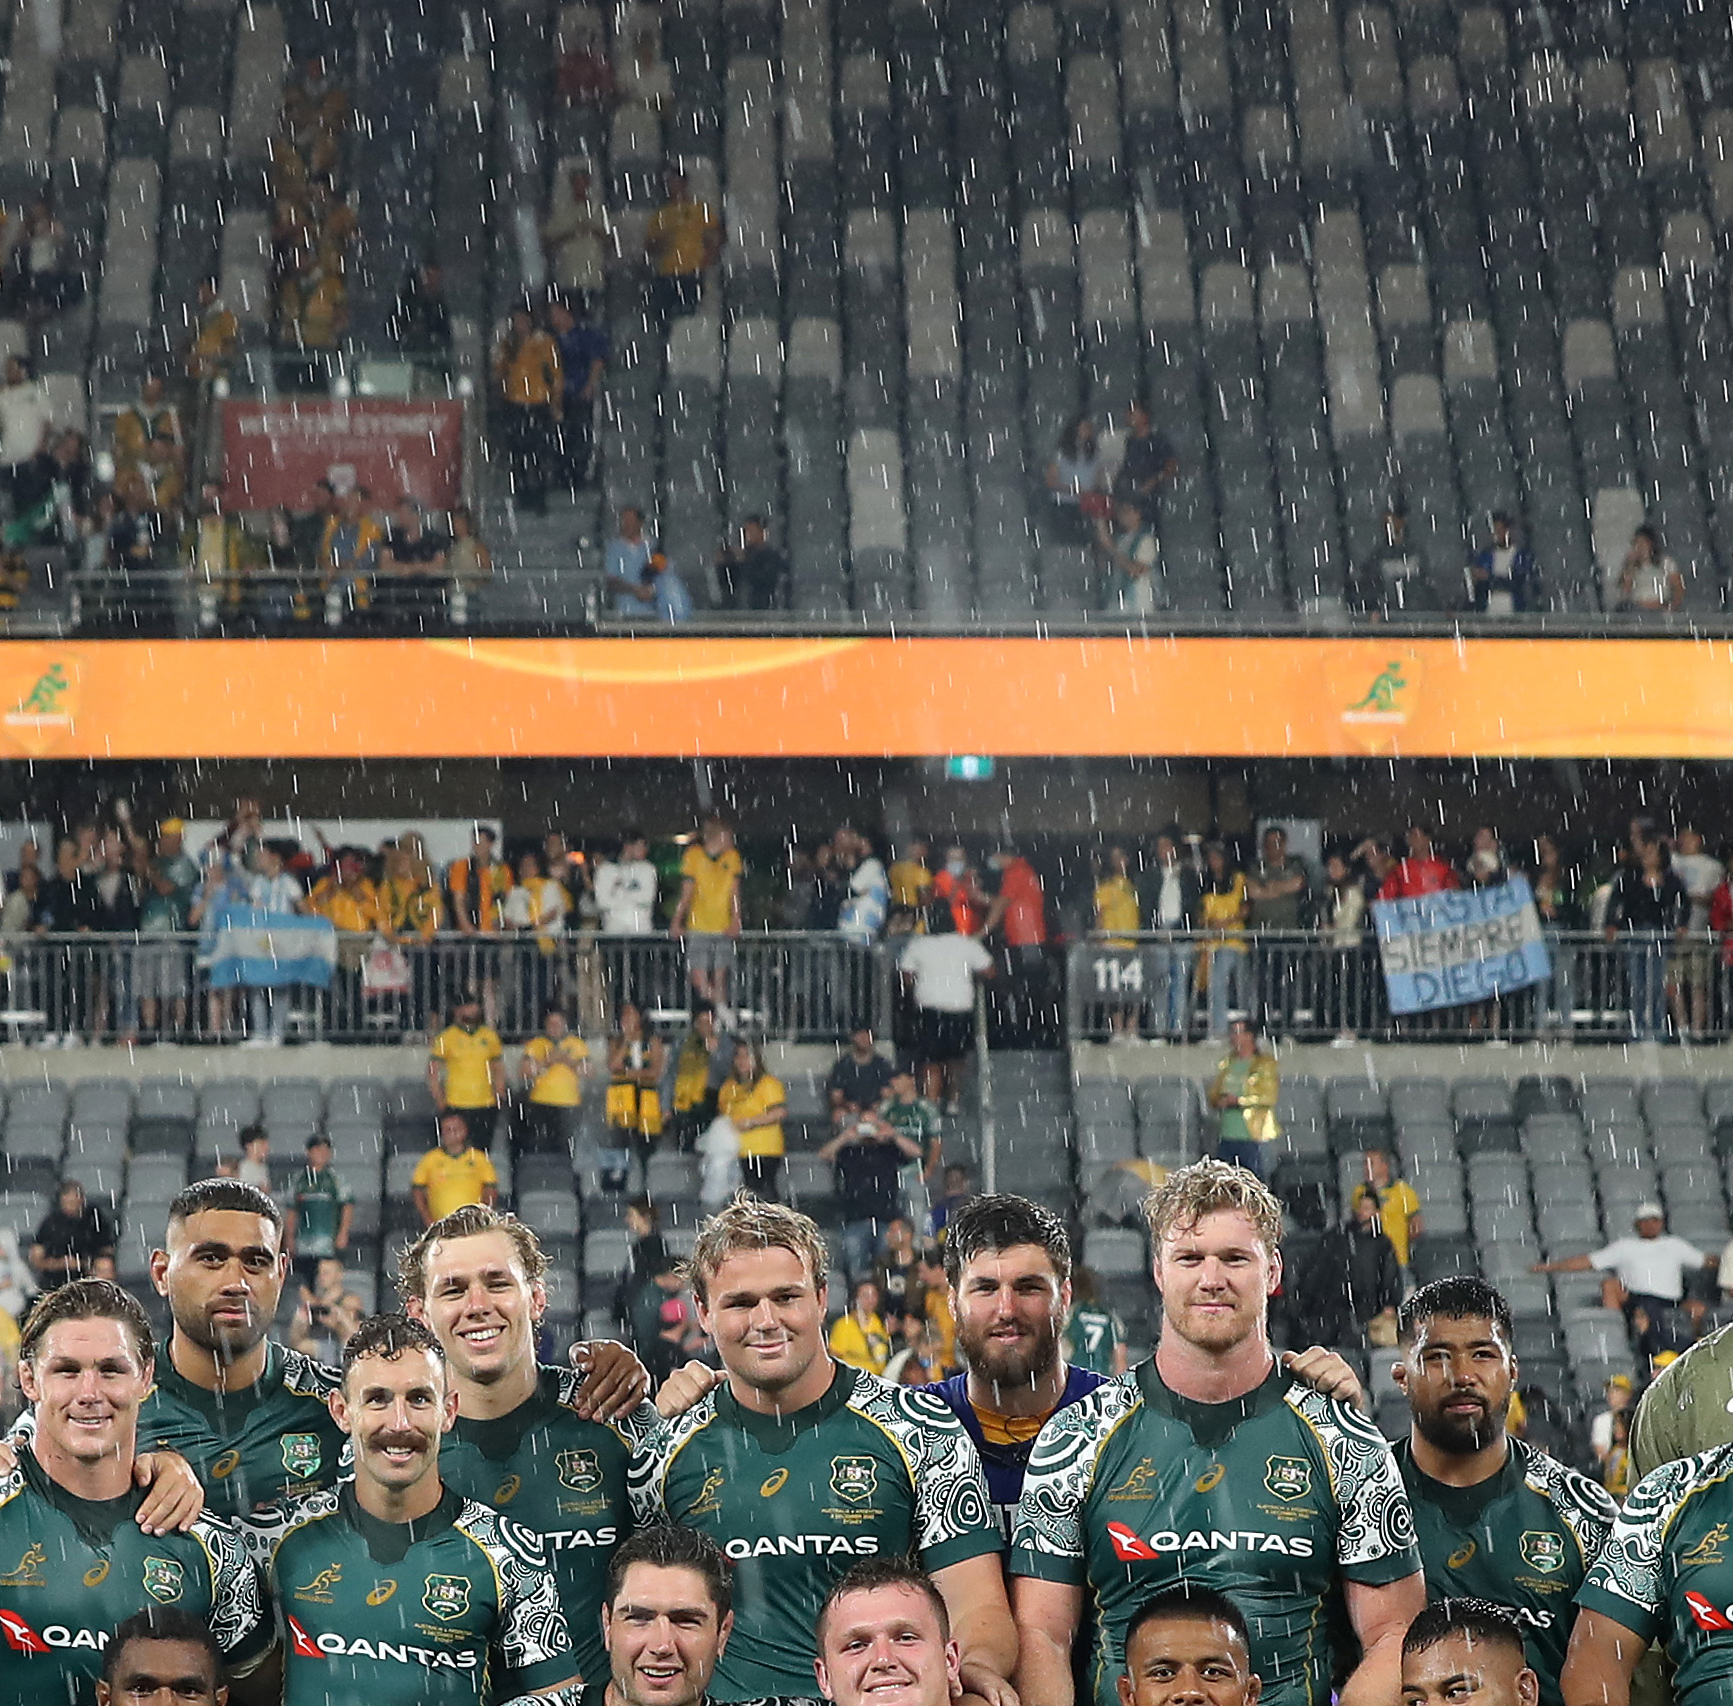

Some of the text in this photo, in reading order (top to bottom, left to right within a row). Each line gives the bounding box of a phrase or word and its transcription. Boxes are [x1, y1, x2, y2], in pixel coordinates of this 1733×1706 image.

[1381, 913, 1524, 973] SIEMPRE
[1093, 958, 1143, 991] 114
[1414, 950, 1529, 1003] DIEGO
[1084, 1324, 1104, 1352] 7
[725, 1534, 879, 1560] QANTAS
[1149, 1530, 1314, 1557] QANTAS
[317, 1632, 477, 1669] QANTAS
